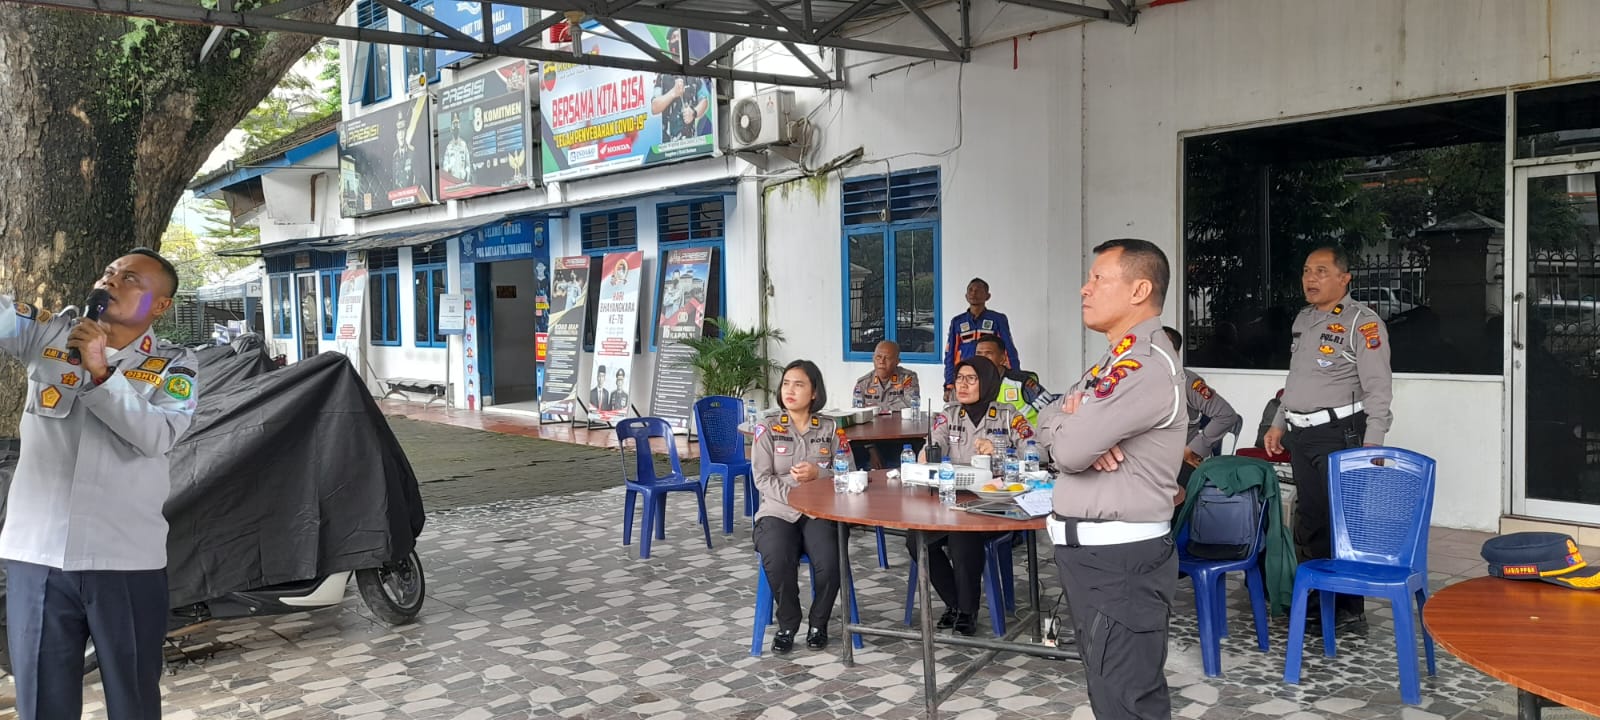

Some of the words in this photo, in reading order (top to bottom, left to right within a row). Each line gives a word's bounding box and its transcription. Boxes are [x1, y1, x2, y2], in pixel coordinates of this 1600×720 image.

[552, 87, 595, 128] BERSAMA
[597, 81, 618, 116] KITA
[621, 75, 646, 111] BISA
[473, 106, 483, 132] 8
[483, 101, 522, 122] KOMITMEN
[607, 143, 631, 153] HONDA
[600, 301, 636, 313] BHAYANGKARA
[1320, 333, 1345, 345] POLRI
[125, 370, 161, 385] DISHUB
